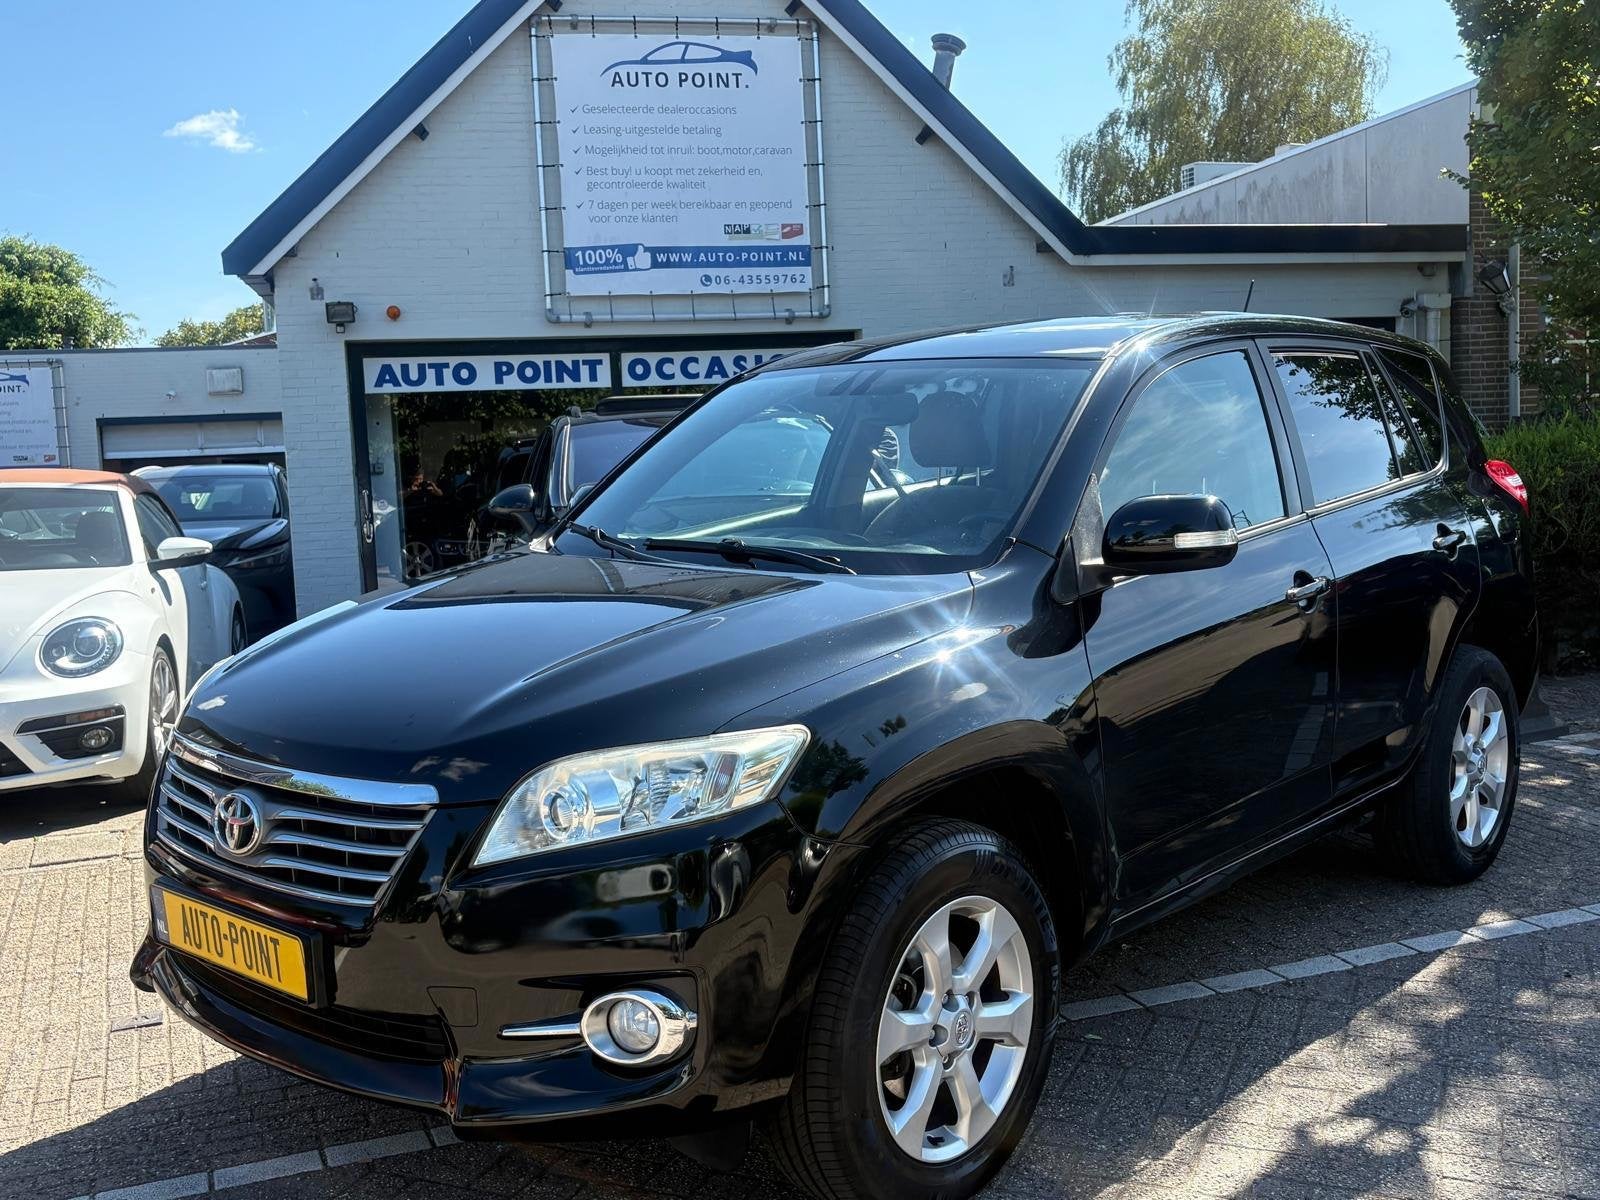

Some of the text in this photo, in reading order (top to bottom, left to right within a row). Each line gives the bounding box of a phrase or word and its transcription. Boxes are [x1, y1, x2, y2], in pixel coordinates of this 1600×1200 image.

[610, 71, 750, 89] AUTO POINT.
[582, 104, 737, 115] Geselecteerde dealeroccasions
[583, 125, 722, 138] Leasing-uitgestelde betaling
[585, 145, 647, 157] Mogelijkheid
[650, 146, 664, 155] tot
[697, 145, 792, 156] boot,motor,caravan
[586, 166, 608, 176] Best
[635, 168, 642, 176] u
[644, 166, 672, 178] koopt
[676, 168, 694, 176] met
[698, 166, 745, 176] zekerheid
[586, 180, 706, 191] gecontroleerde kwaliteit
[588, 200, 792, 212] 7 dagen per week bereikbaar en geopend
[588, 213, 678, 223] voor onze klanten
[575, 248, 623, 266] 100%
[656, 251, 805, 263] WWW.AUTO-POINT.NL
[714, 274, 806, 285] 06-43559762
[373, 362, 477, 388] AUTO
[494, 358, 603, 385] POINT
[156, 919, 168, 934] NL
[180, 903, 282, 984] AUTO-POINT
